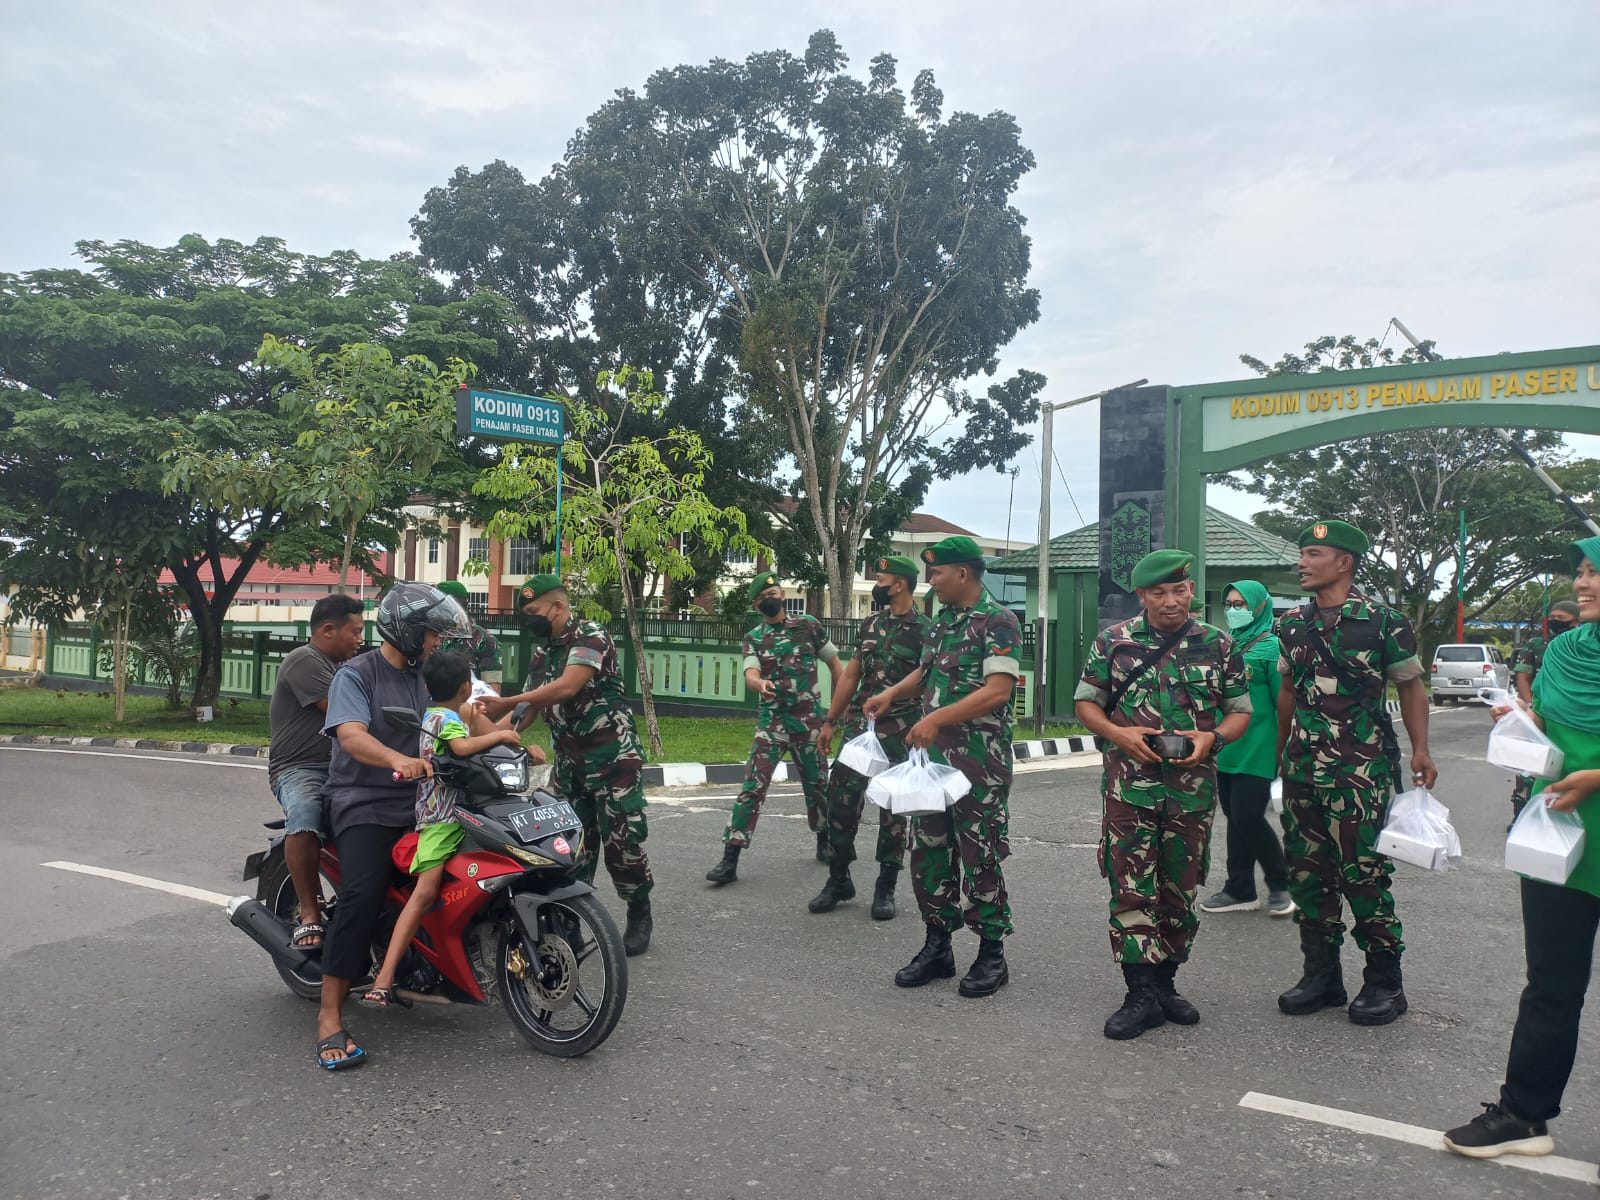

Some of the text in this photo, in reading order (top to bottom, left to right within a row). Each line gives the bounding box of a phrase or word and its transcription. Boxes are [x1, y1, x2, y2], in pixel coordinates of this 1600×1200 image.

[1231, 366, 1600, 418] KODIM 0913 PENAJAM PASER U
[474, 396, 559, 424] KODIM 0913
[475, 418, 559, 438] PENAJAM PASER UTARA
[512, 814, 528, 828] KT
[533, 807, 558, 822] 4059
